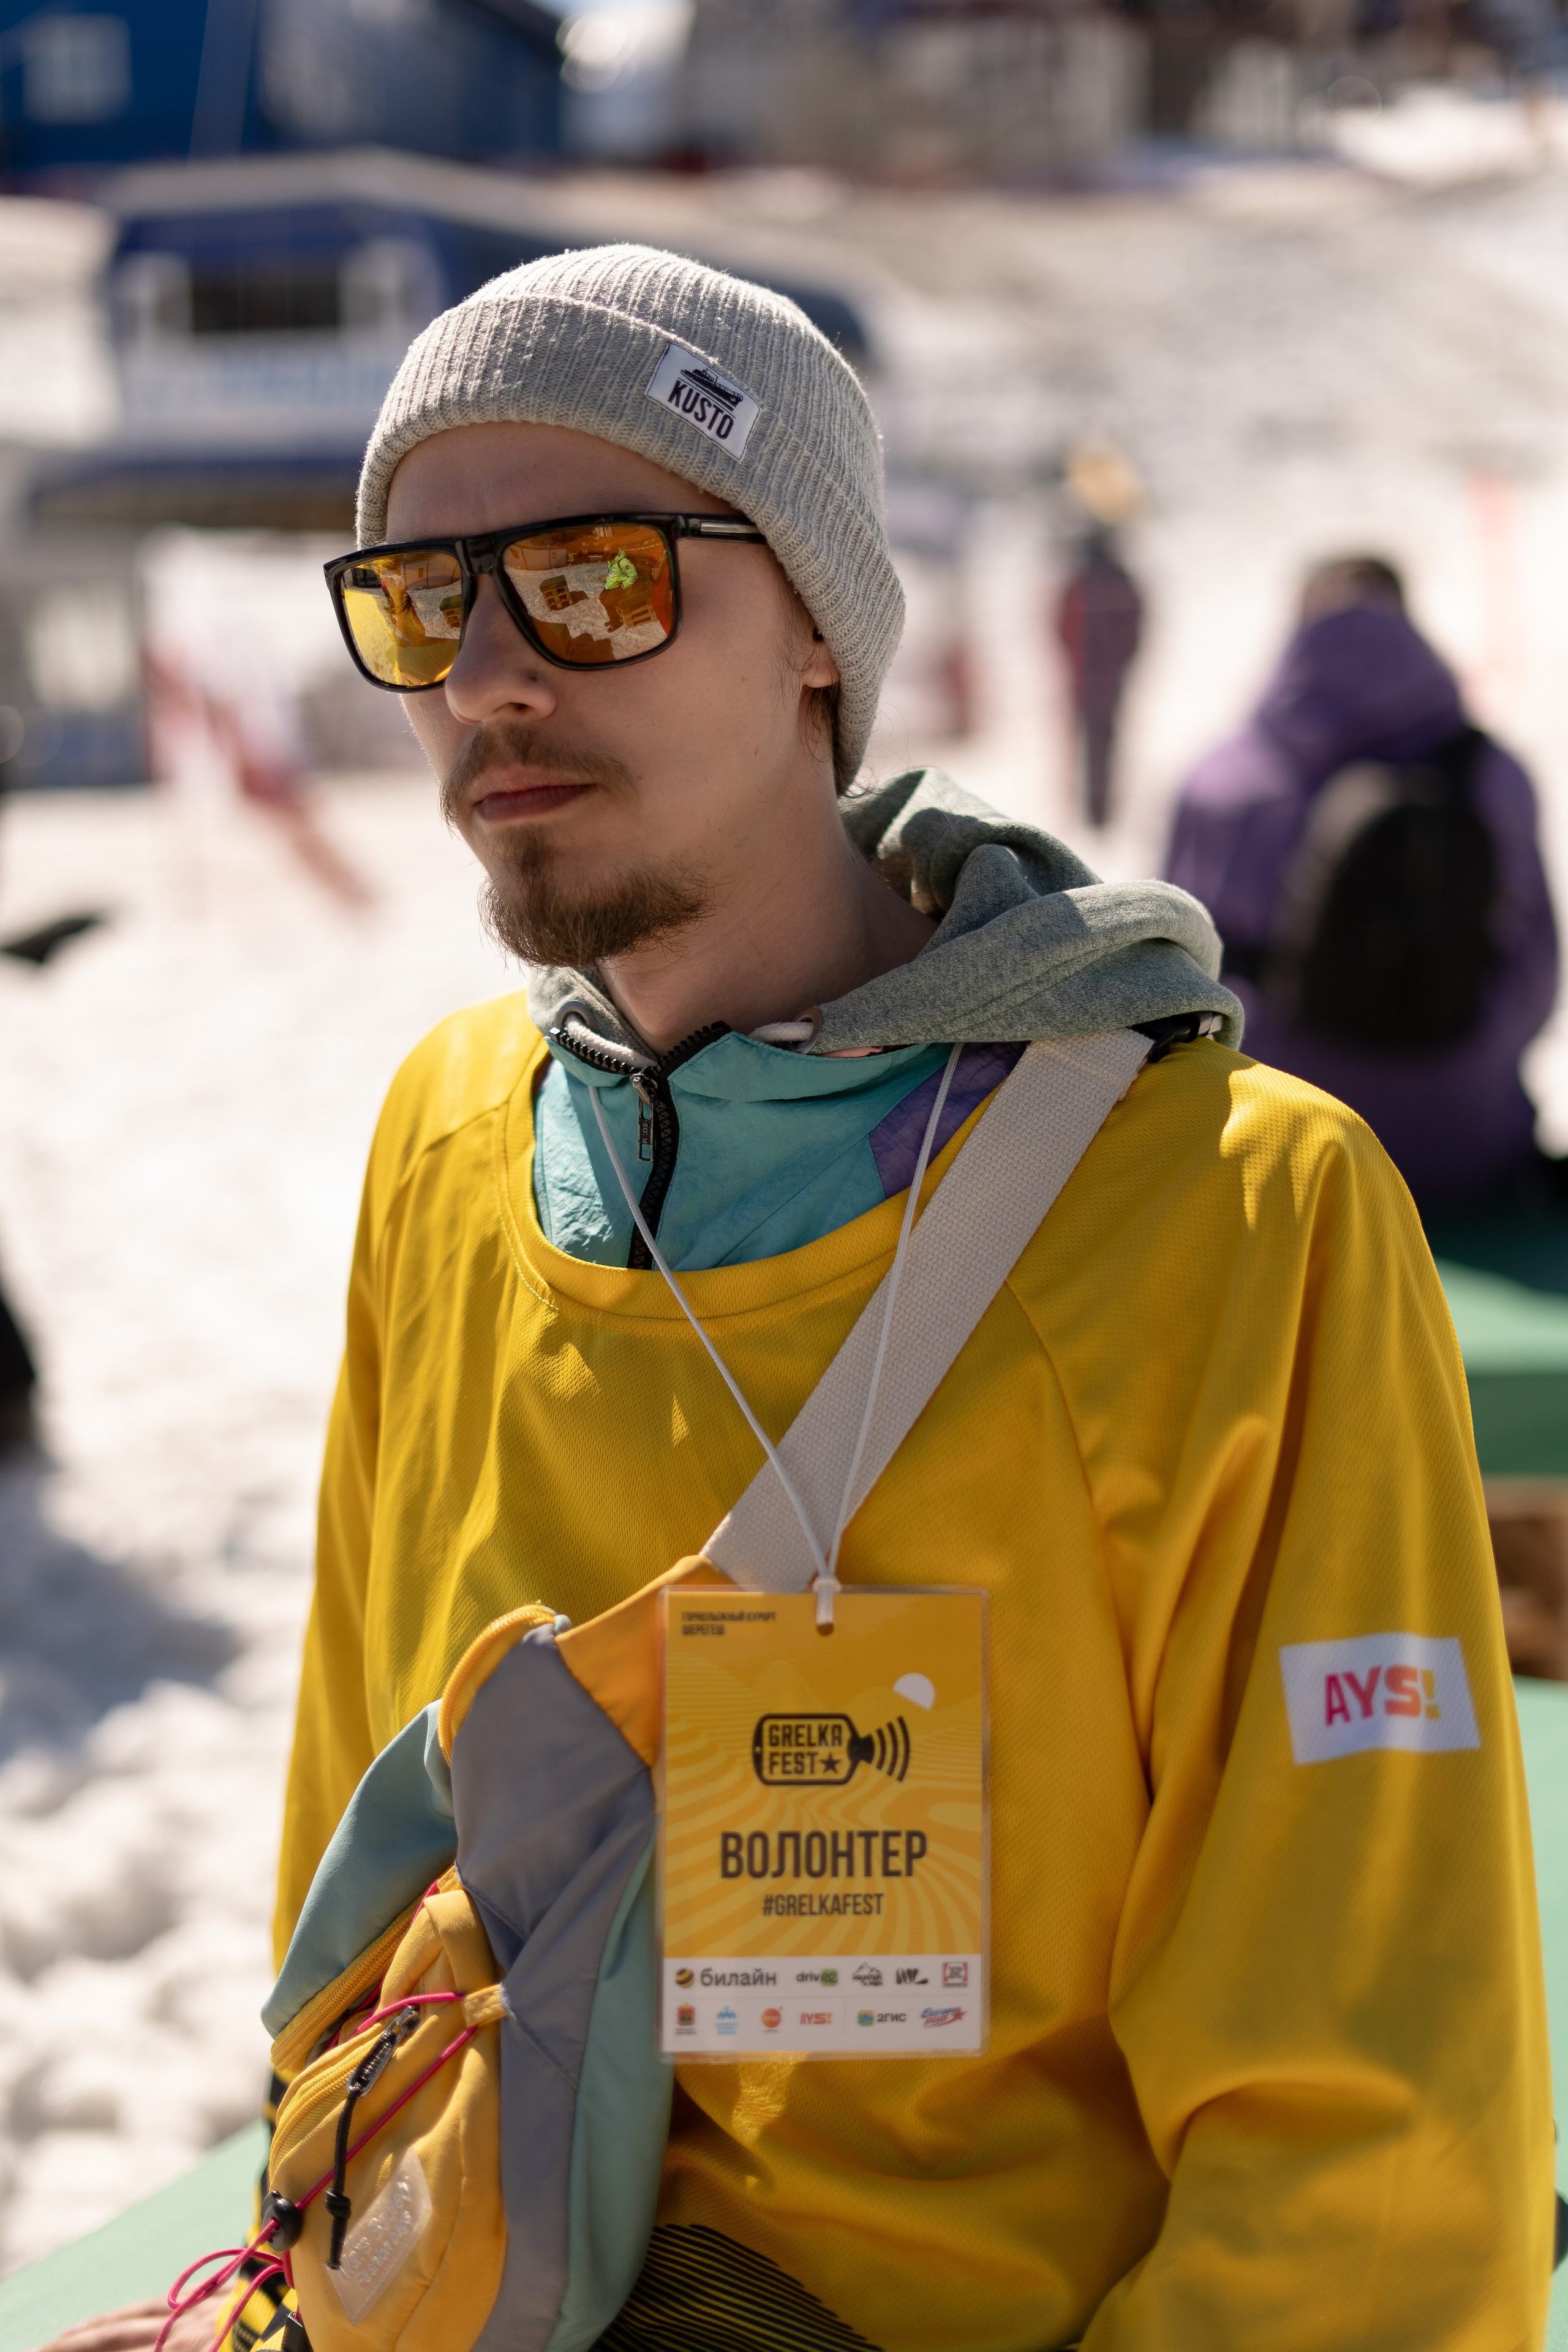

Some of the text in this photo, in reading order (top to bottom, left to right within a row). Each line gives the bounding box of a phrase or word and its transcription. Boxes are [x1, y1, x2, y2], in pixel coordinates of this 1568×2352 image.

[668, 379, 734, 440] KUSTO
[682, 1624, 725, 1635] ШЕРЕГЕШ
[1325, 1664, 1441, 1727] AYS!
[768, 1723, 842, 1747] GRELKA
[768, 1752, 818, 1774] FEST
[721, 1830, 927, 1879] ВОЛОНТЕР
[763, 1893, 884, 1915] #GRELKAFEST
[701, 1967, 777, 1986] билайн
[796, 1970, 838, 1982] drivee
[800, 2012, 832, 2024] AYS!
[877, 2013, 907, 2022] 2ГИС
